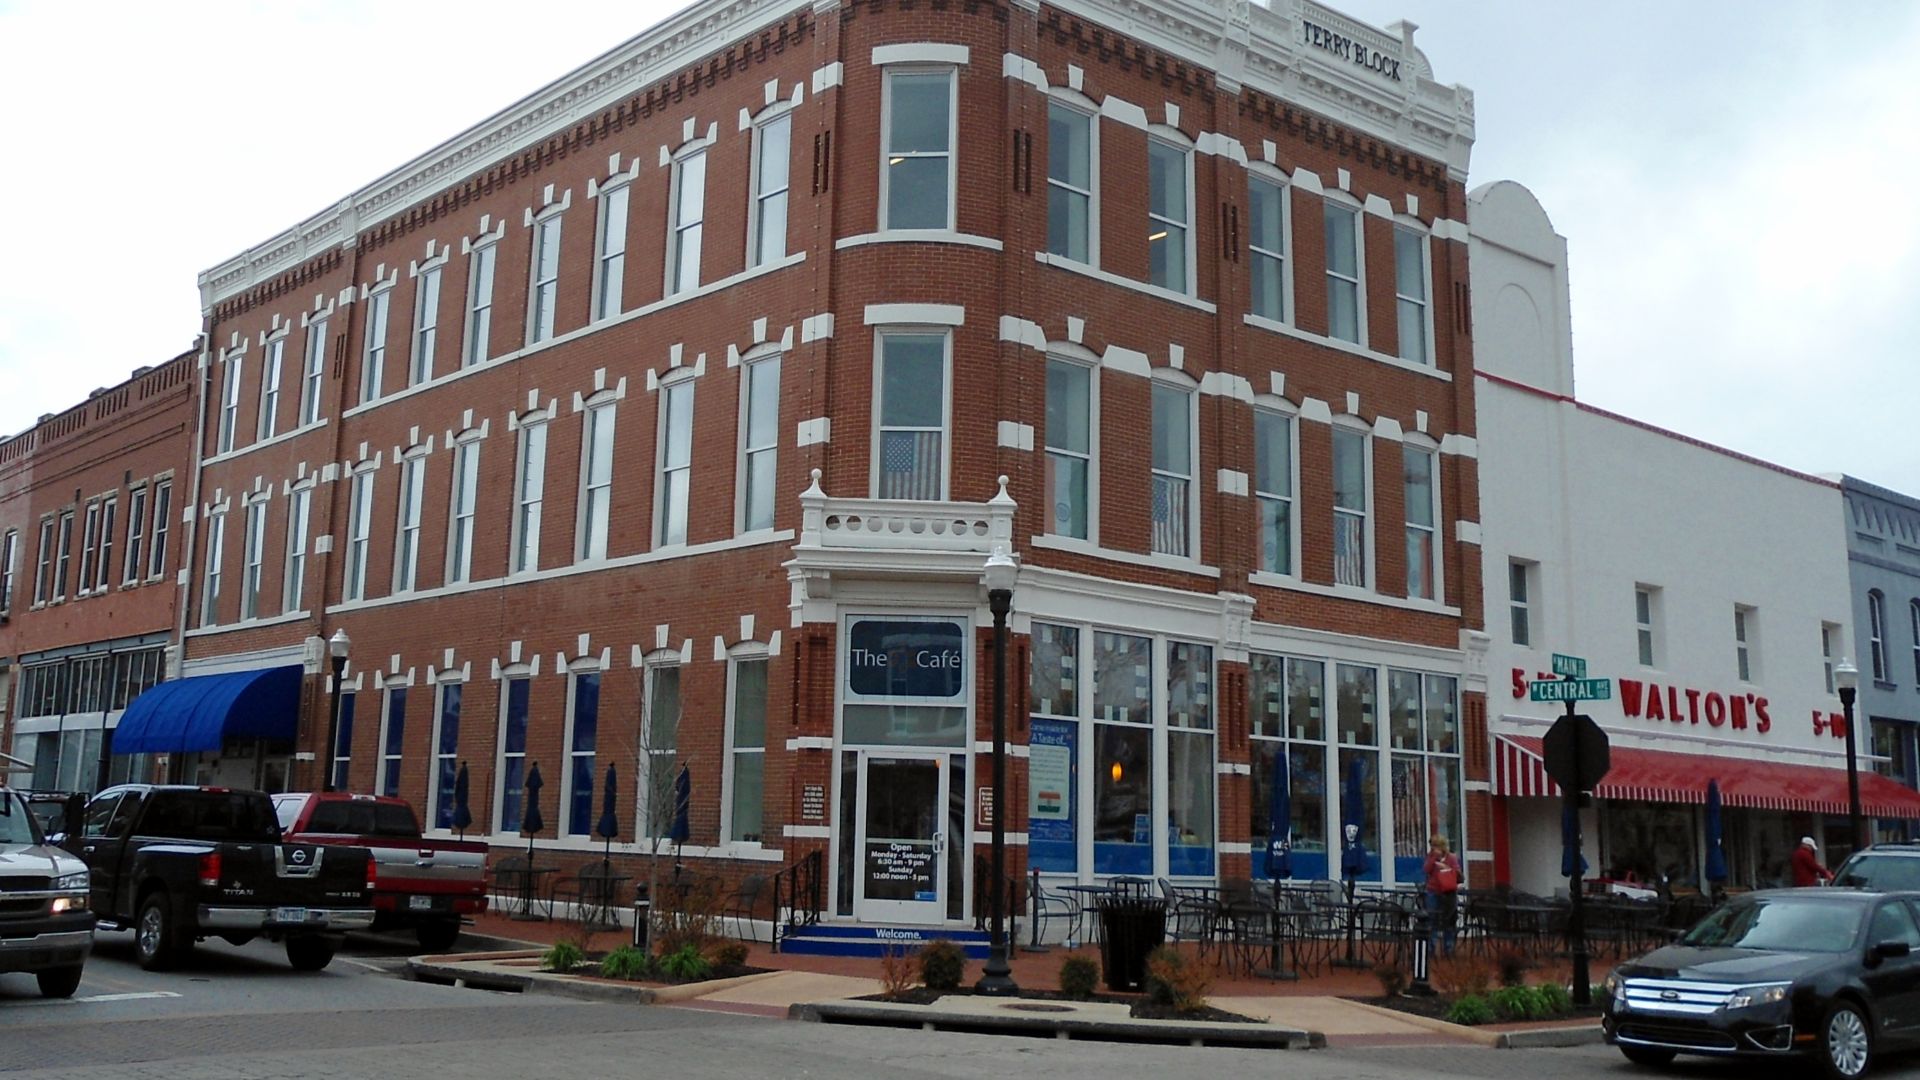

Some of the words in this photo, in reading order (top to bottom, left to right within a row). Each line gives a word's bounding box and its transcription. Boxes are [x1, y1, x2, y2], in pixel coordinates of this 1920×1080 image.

[1303, 20, 1351, 60] TERRY
[1353, 43, 1400, 81] BLOCK
[851, 648, 888, 667] The
[916, 649, 961, 668] Café
[1557, 656, 1578, 676] MAIN
[1540, 681, 1594, 699] CENTRAL
[1619, 678, 1771, 734] WALTON'S
[890, 843, 912, 851] Open
[871, 851, 897, 859] Monday
[902, 852, 931, 861] Saturday
[888, 866, 913, 874] Sunday
[224, 888, 254, 896] TITAN
[875, 928, 922, 940] Welcome.
